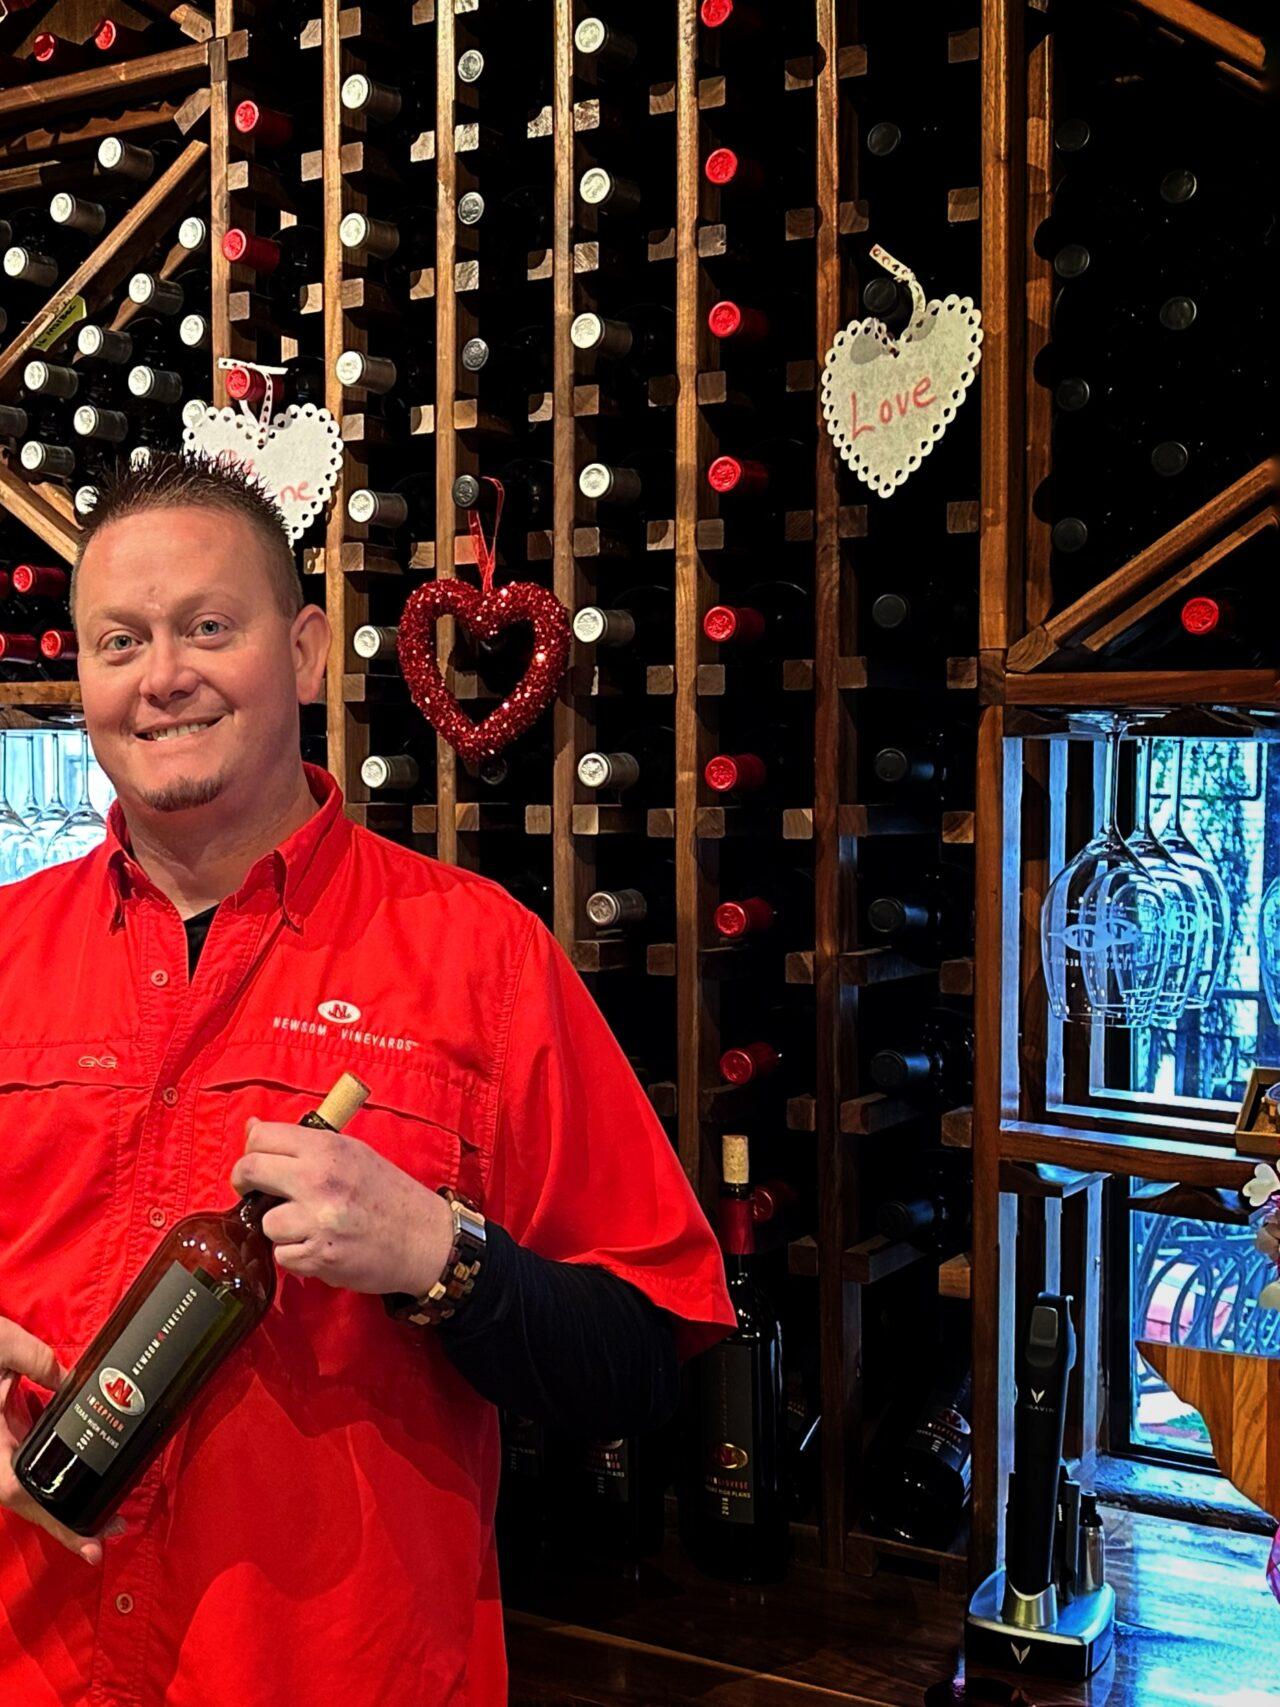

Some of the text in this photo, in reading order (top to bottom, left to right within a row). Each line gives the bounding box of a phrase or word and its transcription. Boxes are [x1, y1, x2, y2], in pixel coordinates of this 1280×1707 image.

[851, 376, 937, 441] Love
[272, 1016, 413, 1052] NEWSOM VINEYARDS
[132, 1288, 198, 1376] NEWSOM VINEYARDS
[73, 1403, 89, 1421] TEXAS
[99, 1429, 120, 1449] PLAINS
[86, 1393, 125, 1433] INCEPTION
[76, 1429, 94, 1451] 2019
